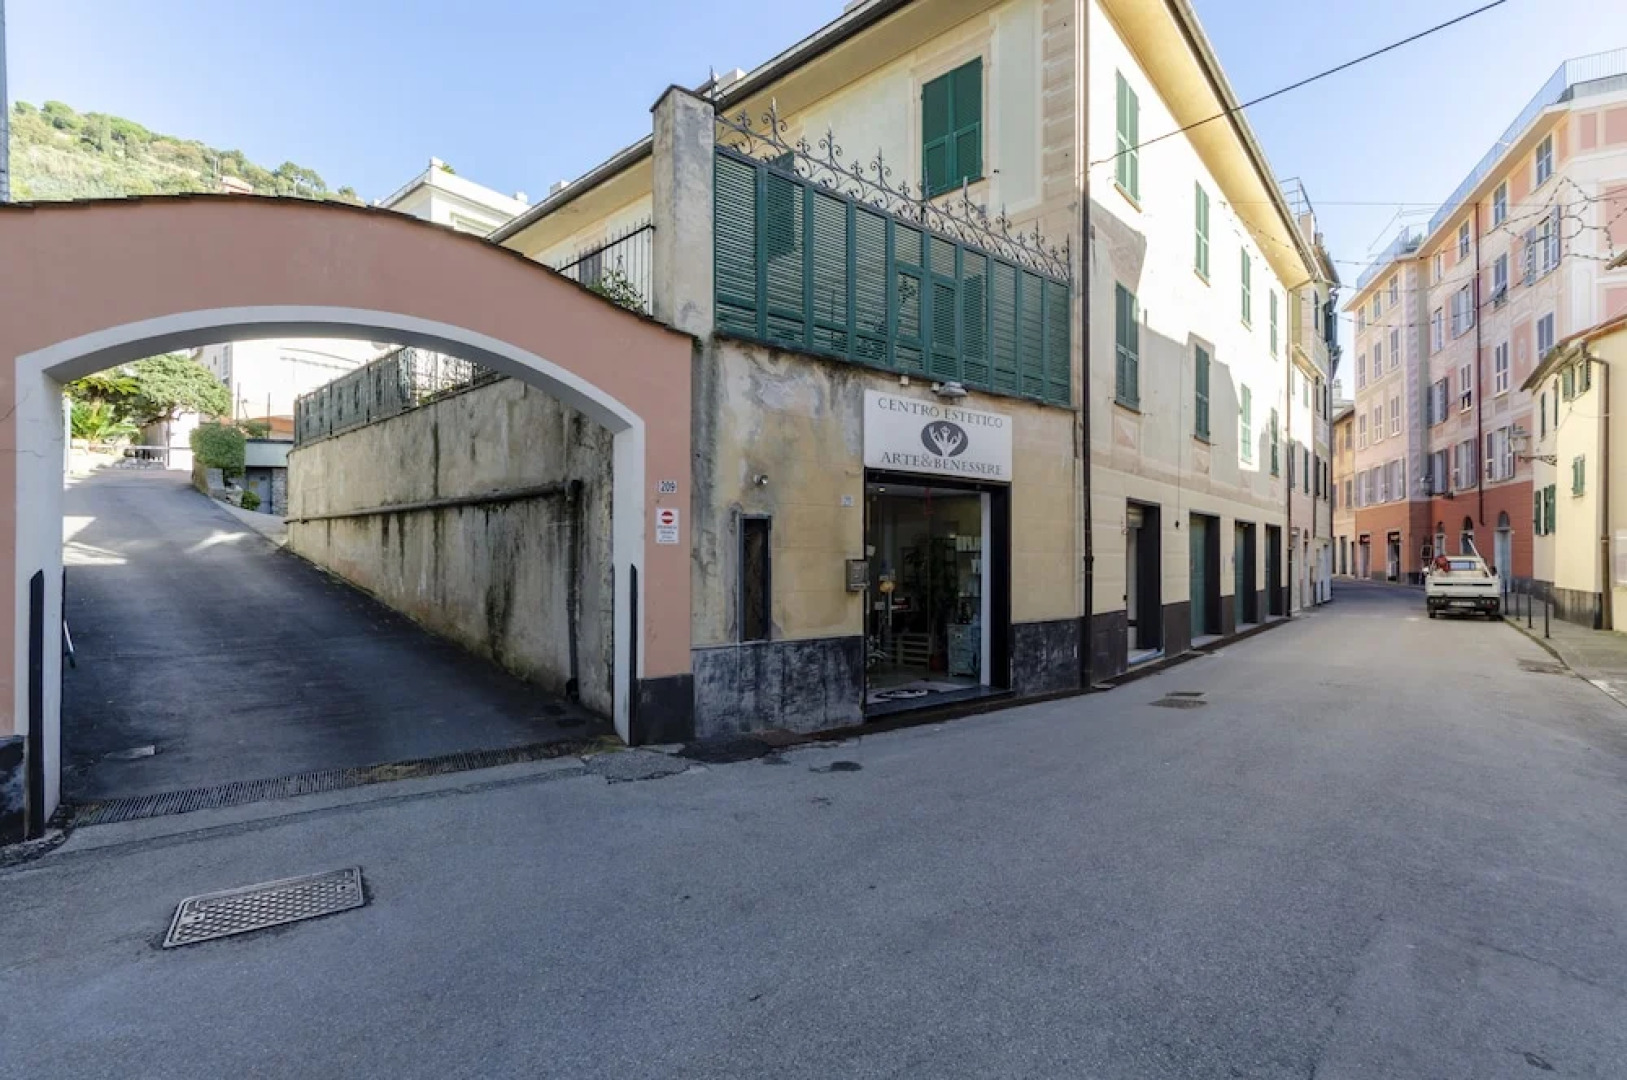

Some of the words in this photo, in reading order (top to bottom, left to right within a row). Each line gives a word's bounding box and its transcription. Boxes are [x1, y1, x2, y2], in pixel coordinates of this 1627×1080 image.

[878, 396, 939, 417] CENTRO
[945, 407, 1003, 428] ESTETICO
[881, 451, 1002, 475] ARTE&BENESSERE
